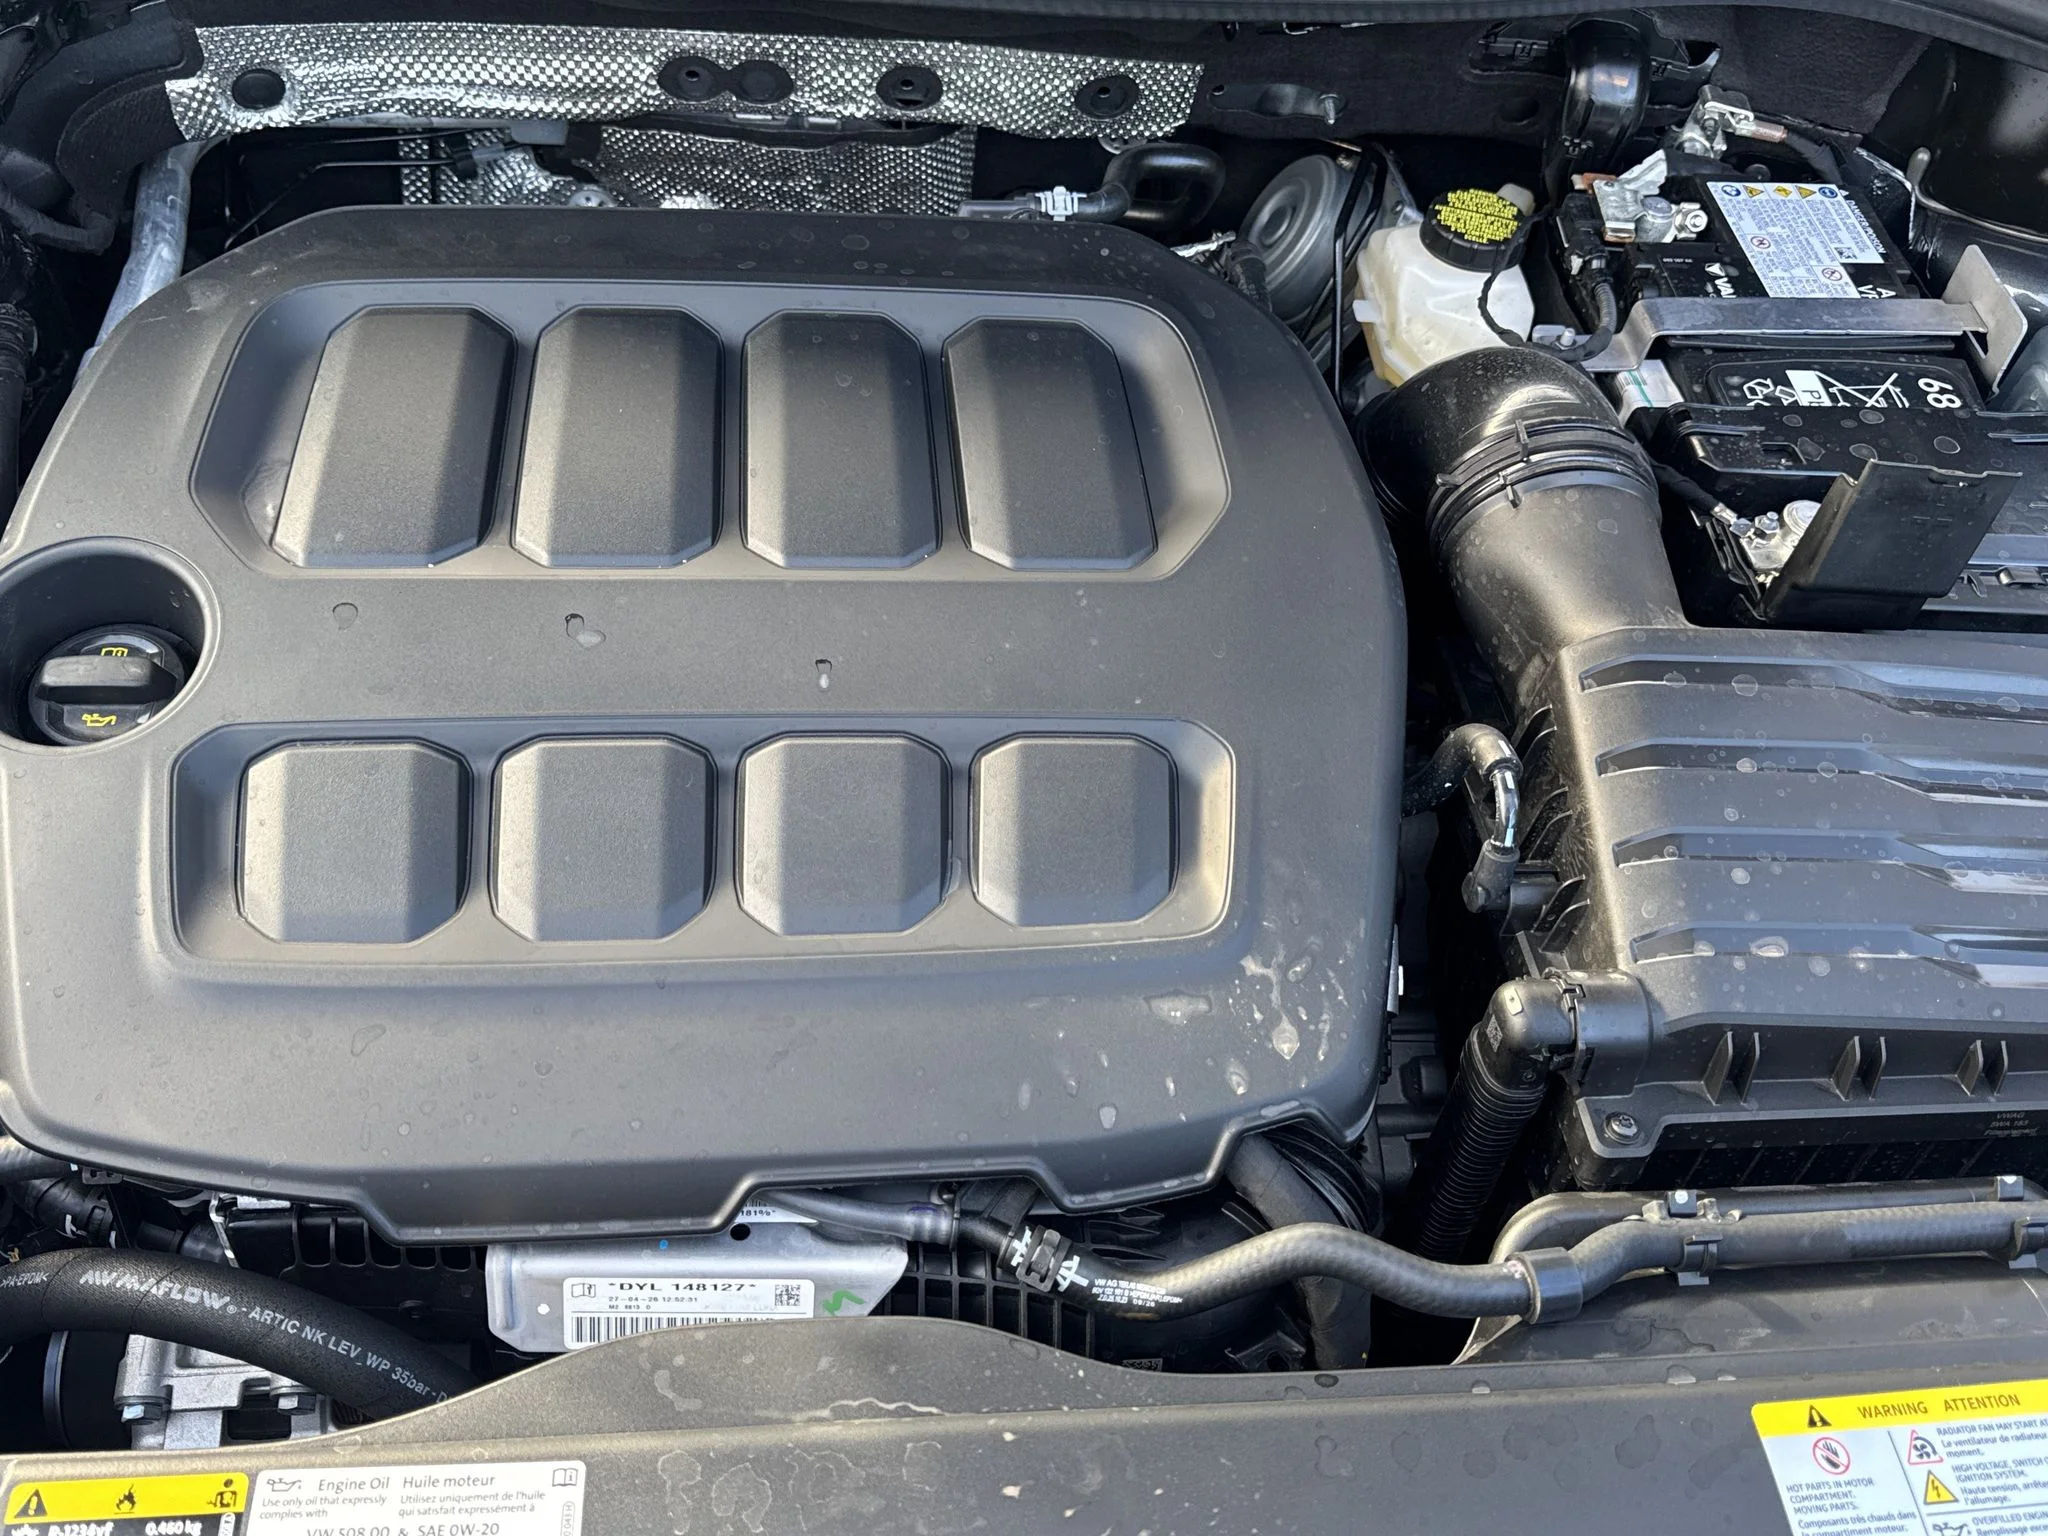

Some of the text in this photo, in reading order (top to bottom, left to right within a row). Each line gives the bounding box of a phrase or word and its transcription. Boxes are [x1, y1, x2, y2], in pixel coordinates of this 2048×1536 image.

[248, 1306, 300, 1335] ARTIC
[301, 1325, 328, 1345] NK
[391, 1367, 431, 1396] 35bar
[1857, 1394, 2021, 1419] WARNING ATTENTION
[1936, 1425, 1977, 1436] RADIATOR
[1978, 1423, 1995, 1433] FAN
[1995, 1422, 2013, 1431] MAY
[2014, 1419, 2038, 1429] START
[1953, 1436, 1998, 1447] ventilateur
[2000, 1434, 2009, 1443] de
[1952, 1464, 1973, 1473] HIGH
[2012, 1457, 2043, 1468] SWITCH
[403, 1475, 496, 1488] Huile moteur
[1956, 1471, 1993, 1482] IGNITION
[318, 1477, 390, 1494] Engine Oil
[1786, 1477, 1874, 1493] HOT PARTS IN MOTOR
[1960, 1485, 1986, 1495] Haute
[262, 1493, 387, 1509] Use only oil that expressly
[400, 1490, 546, 1506] Utilisez uniquement de l'huile
[259, 1507, 328, 1521] complies with
[398, 1503, 535, 1517] qui satisfait expressément à
[1793, 1504, 1829, 1515] MOVING
[1797, 1508, 1917, 1530] Composants très chauds dans
[1971, 1513, 2022, 1525] OVERFILLED
[306, 1528, 338, 1536] VW
[369, 1526, 390, 1536] 00
[397, 1527, 409, 1536] &
[417, 1525, 445, 1536] SAE
[449, 1523, 500, 1536] 0W-20
